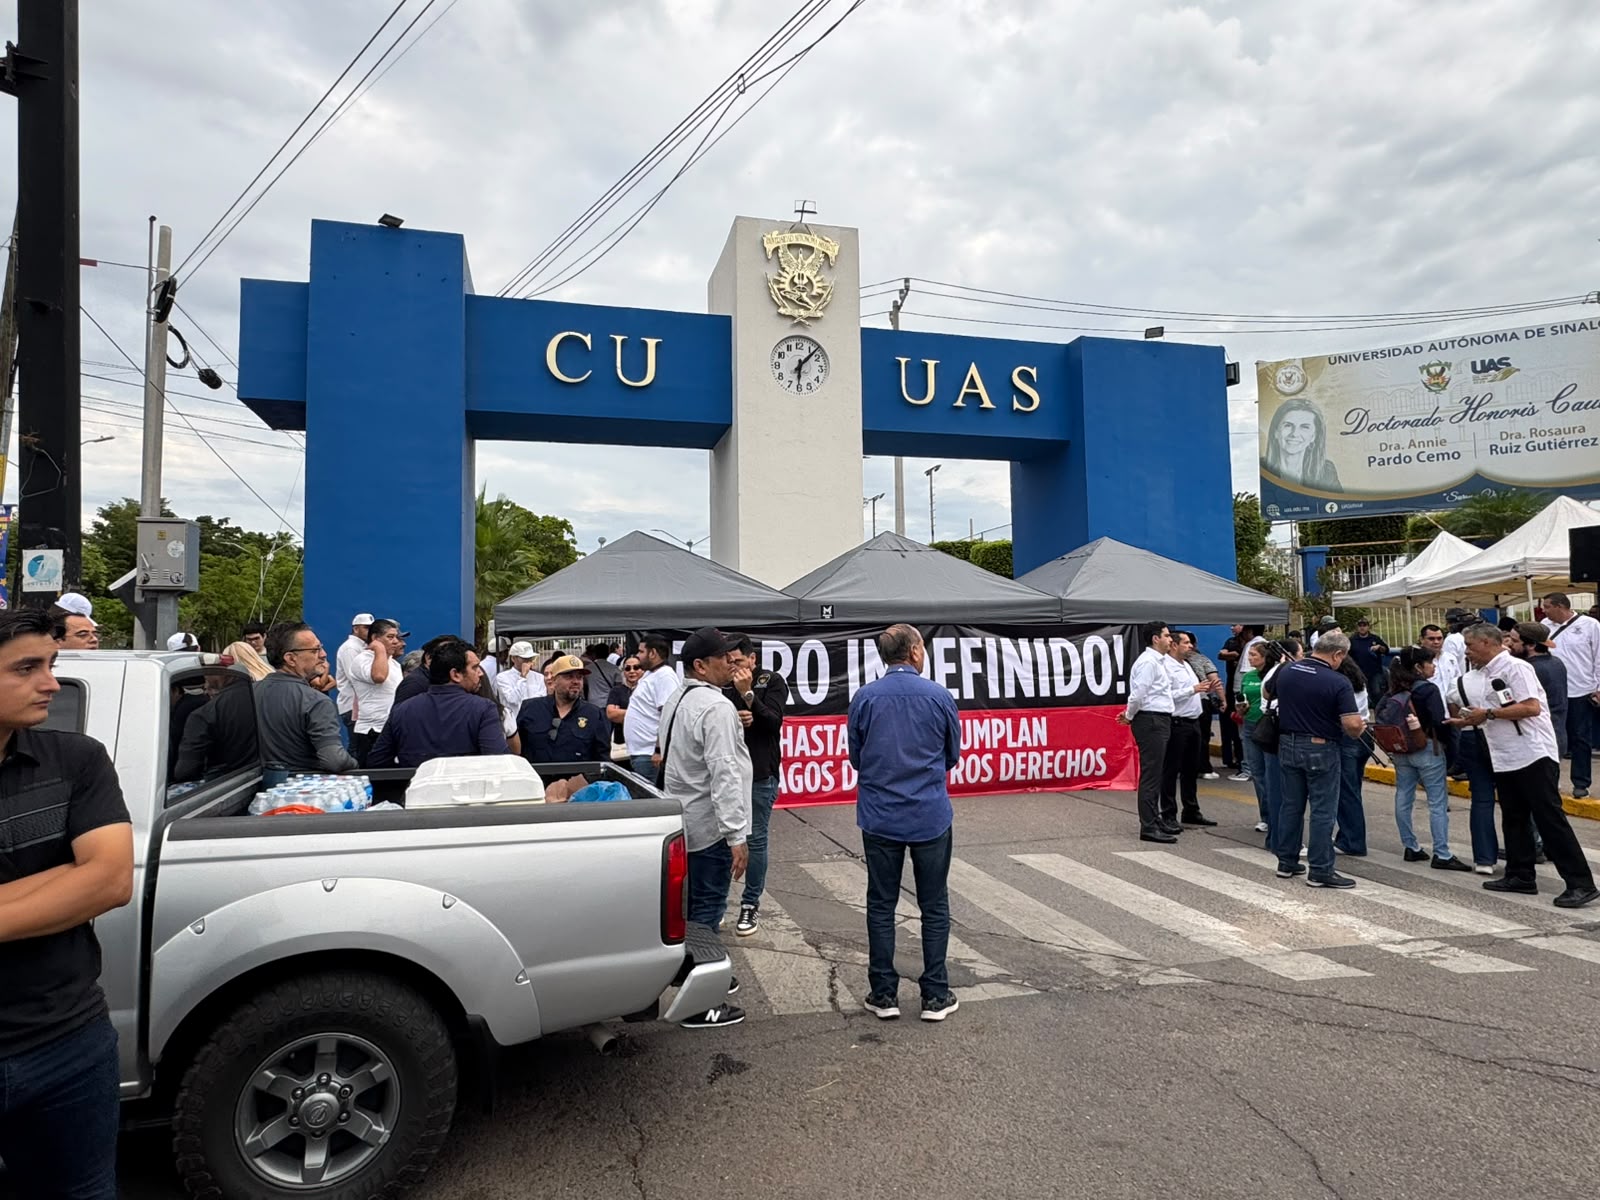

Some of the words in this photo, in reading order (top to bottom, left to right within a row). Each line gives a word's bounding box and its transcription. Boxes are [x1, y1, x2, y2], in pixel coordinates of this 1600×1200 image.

[545, 331, 662, 387] CU
[1328, 345, 1423, 365] UNIVERSIDAD
[1428, 332, 1520, 352] AUTÓNOMA
[1524, 328, 1546, 340] DE
[1550, 320, 1600, 335] SINAL
[895, 356, 1041, 412] UAS
[1470, 356, 1512, 374] UAS
[1340, 406, 1444, 435] Doctorado
[1449, 392, 1540, 424] Honoris
[1545, 383, 1600, 414] Cau
[1379, 442, 1405, 452] Dra.
[1407, 436, 1447, 449] Annie
[1489, 442, 1521, 456] Ruiz
[1525, 436, 1599, 452] Gutiérrez
[1500, 431, 1526, 441] Dra.
[1529, 425, 1586, 438] Rosaura
[1367, 453, 1412, 467] Pardo
[779, 724, 850, 758] HASTA
[960, 716, 1047, 750] UMPLAN
[778, 760, 836, 794] AGOS
[999, 748, 1107, 782] DERECHOS
